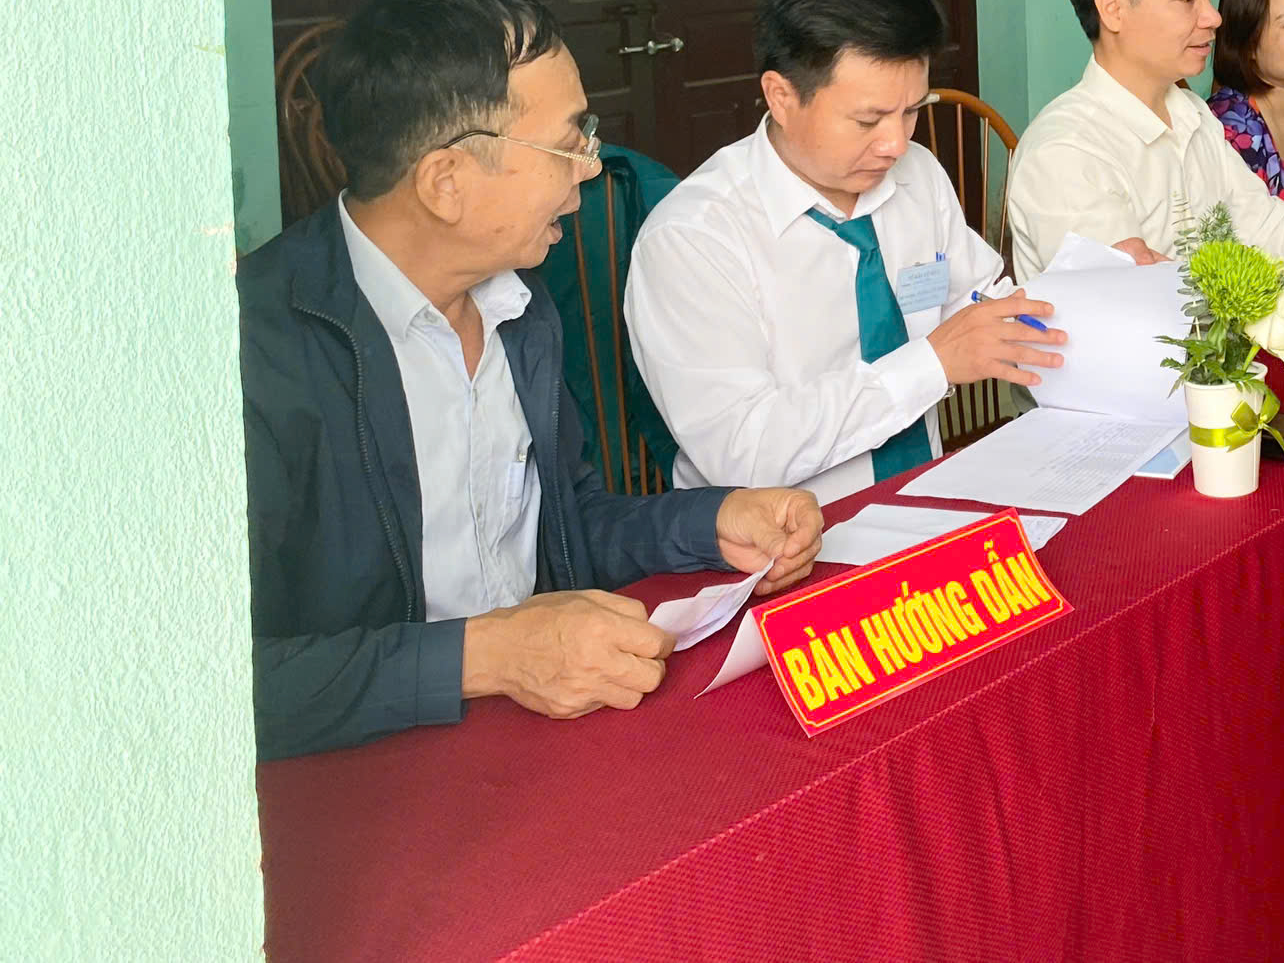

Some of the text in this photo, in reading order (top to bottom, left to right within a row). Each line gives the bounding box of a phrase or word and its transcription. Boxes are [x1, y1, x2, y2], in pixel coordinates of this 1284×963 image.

[782, 540, 1052, 711] BÀN HƯỚNG DẪN
